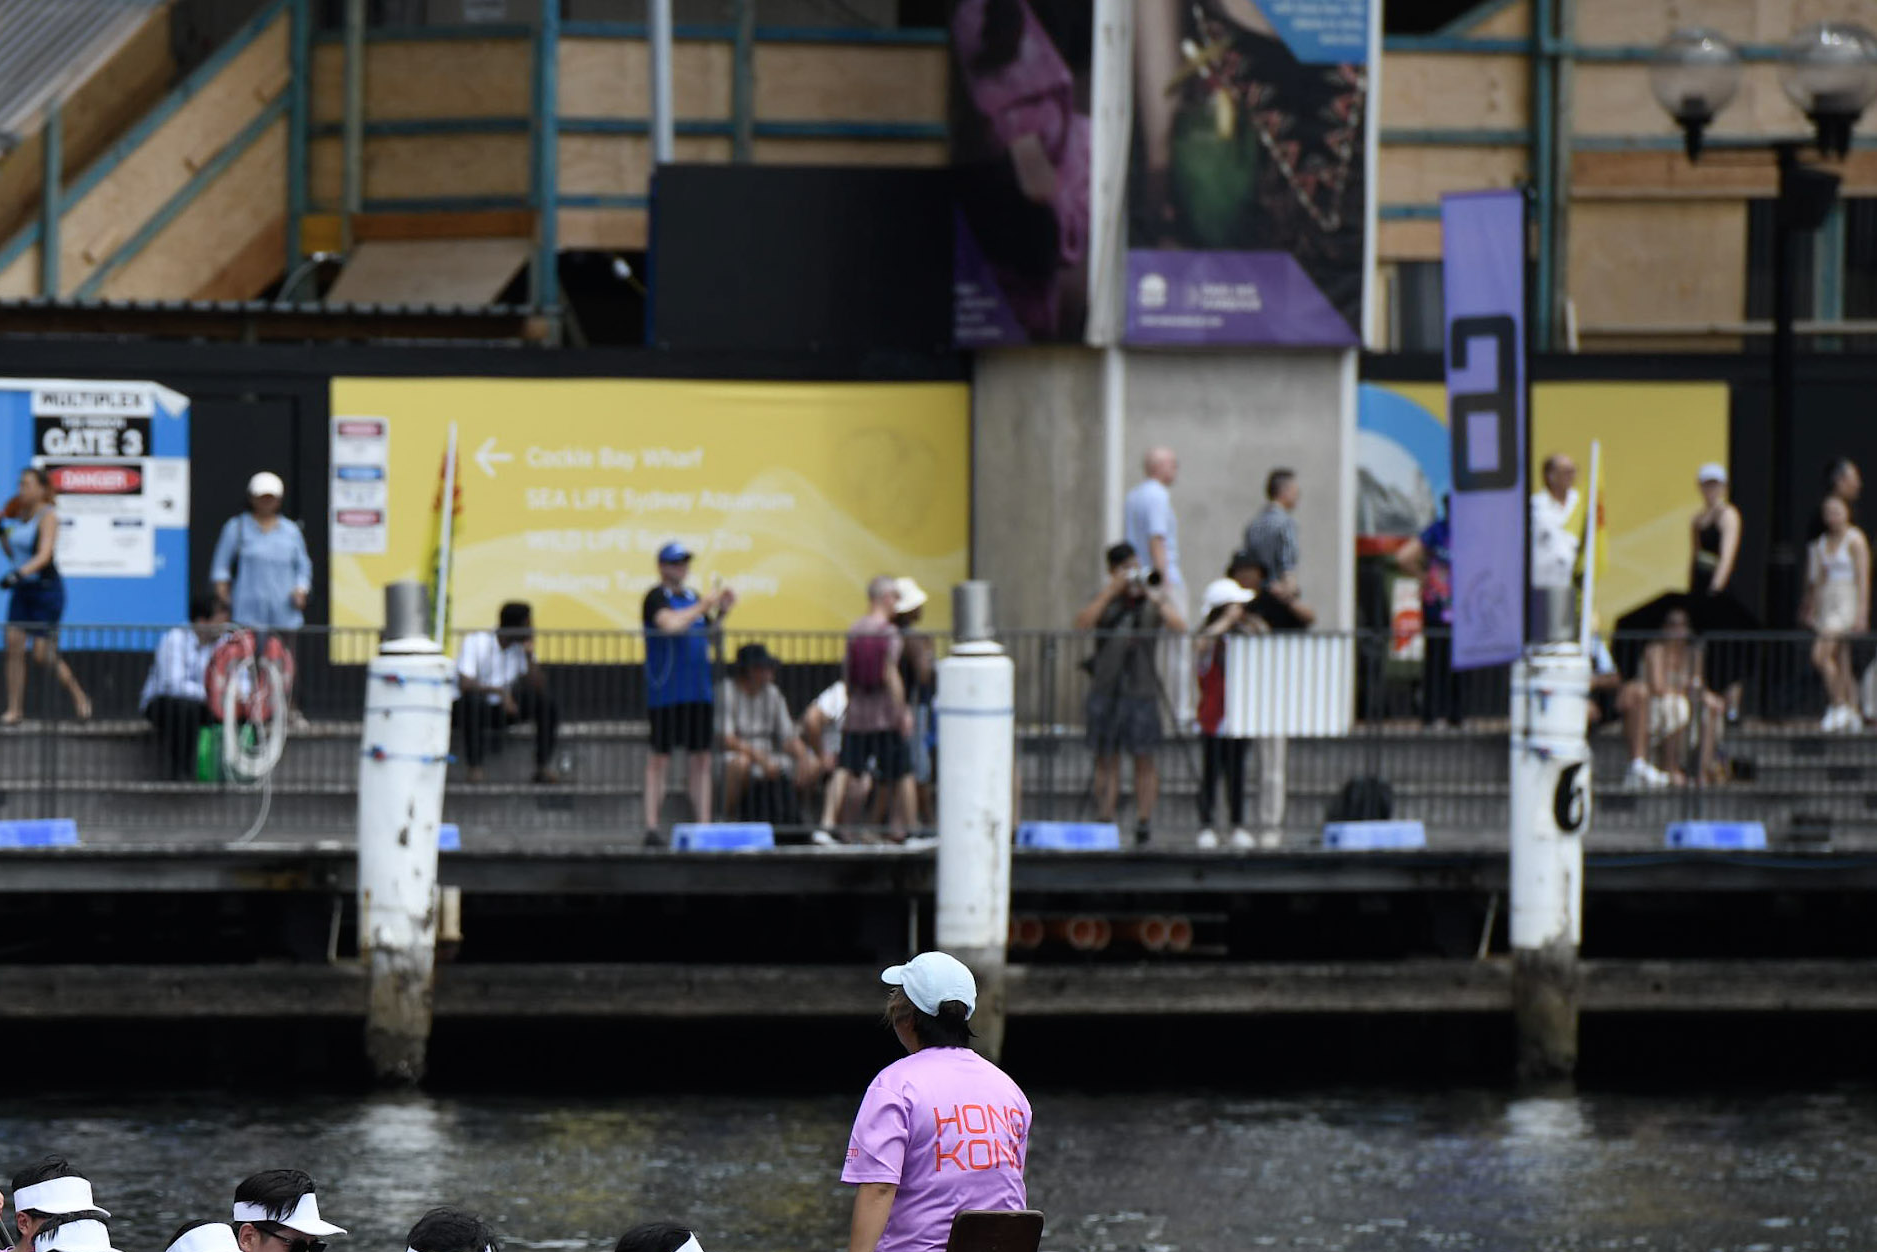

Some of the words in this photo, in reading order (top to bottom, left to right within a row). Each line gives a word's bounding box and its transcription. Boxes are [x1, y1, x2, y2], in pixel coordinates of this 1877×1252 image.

[42, 427, 118, 457] GATE
[121, 428, 144, 458] 3
[527, 446, 593, 468] Cockle
[599, 447, 636, 471] Bay
[642, 446, 704, 468] Wharf
[60, 469, 126, 490] DANGER
[527, 488, 567, 511] SEA
[572, 488, 616, 511] LIFE
[623, 488, 694, 515] Sydney
[700, 489, 795, 512] Aquarium
[1553, 762, 1585, 832] 6
